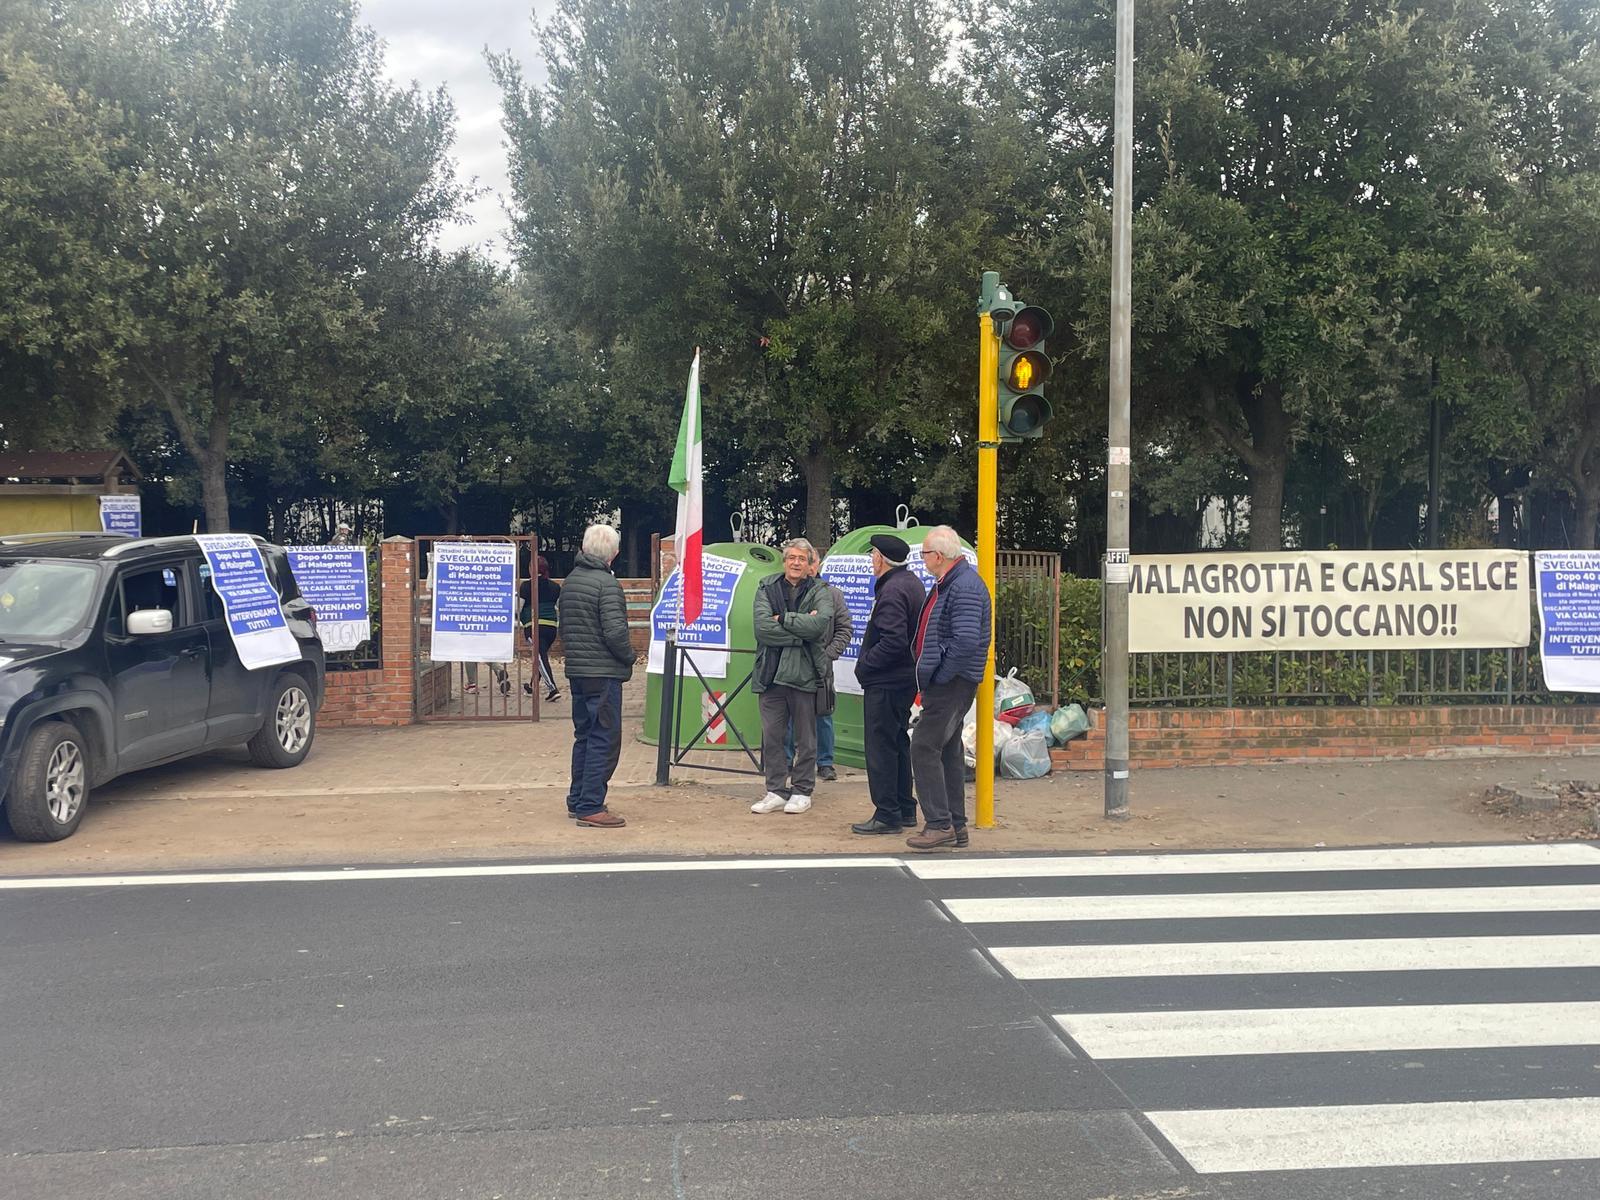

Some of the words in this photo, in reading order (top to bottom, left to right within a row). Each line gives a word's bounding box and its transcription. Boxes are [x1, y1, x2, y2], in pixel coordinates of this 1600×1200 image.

[297, 554, 320, 562] Dopo
[440, 554, 506, 564] SVEGLIAMOCI
[308, 561, 352, 569] Malagrotta
[448, 564, 470, 573] Dopo
[471, 564, 483, 572] 40
[825, 564, 873, 573] SVEGLIAMOC
[1544, 561, 1600, 570] SVEGLIAM
[458, 572, 501, 581] Malagrotta
[829, 576, 845, 584] Dopo
[846, 575, 856, 584] 40
[856, 576, 871, 584] anni
[1128, 562, 1313, 594] MALAGROTTA
[1321, 562, 1335, 592] E
[1342, 562, 1433, 592] CASAL
[1439, 561, 1518, 592] SELCE
[1556, 573, 1581, 581] Dopo
[1556, 582, 1566, 590] di
[1569, 582, 1600, 591] Malagr
[313, 603, 362, 611] RVENIAMO
[231, 607, 278, 622] INTERVENIAMO
[440, 614, 508, 623] INTERVENIAMO
[246, 620, 266, 630] TUTTI
[1184, 605, 1252, 639] NON
[1261, 605, 1286, 638] SI
[1293, 603, 1458, 638] TOCCANO!!
[678, 633, 697, 641] UTTI
[1549, 635, 1600, 644] INTERVEN
